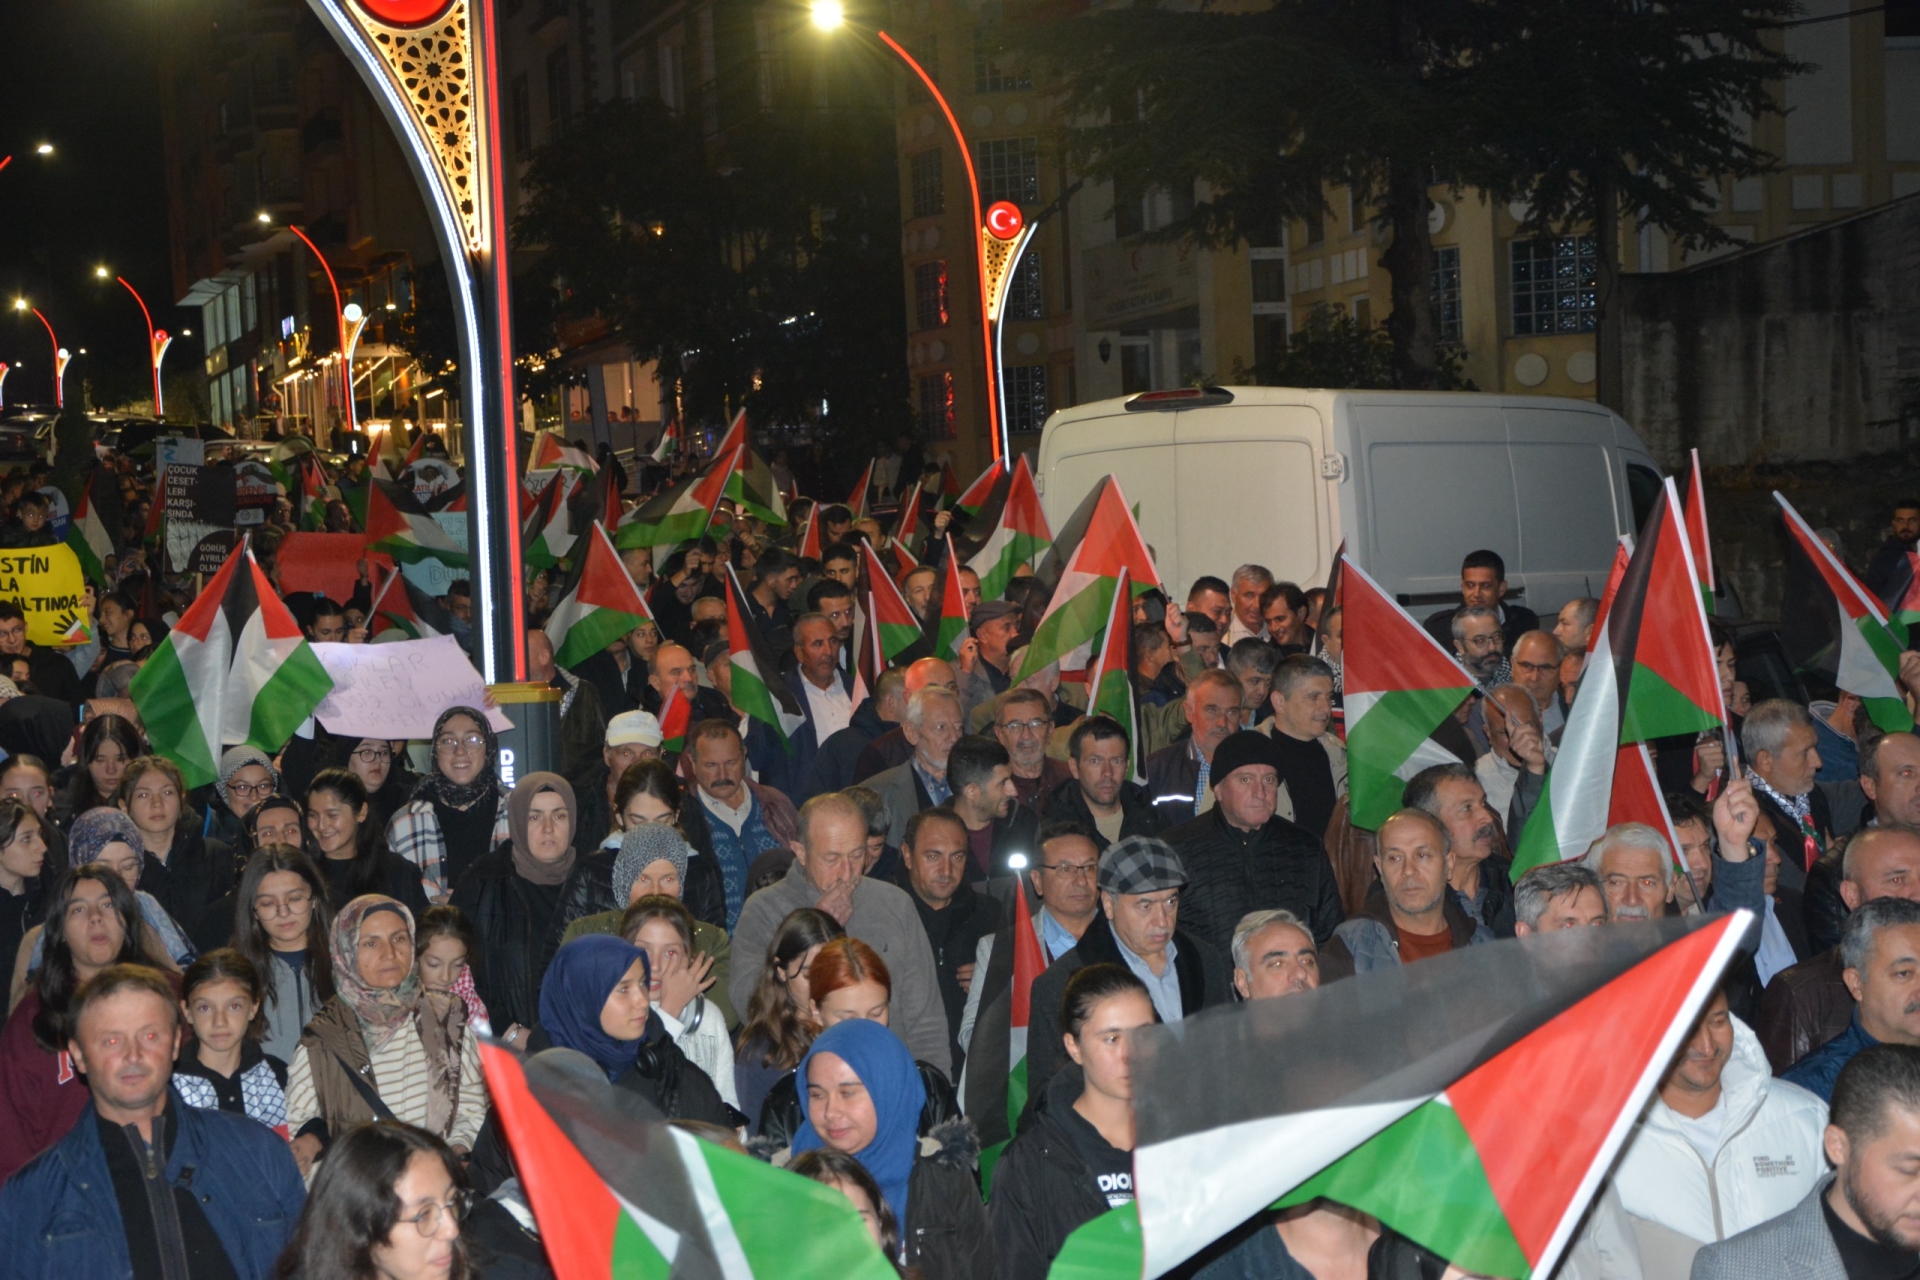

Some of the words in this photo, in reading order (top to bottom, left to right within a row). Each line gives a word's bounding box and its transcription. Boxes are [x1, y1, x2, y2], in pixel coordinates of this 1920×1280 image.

[167, 465, 198, 476] ÇOCUK
[167, 487, 186, 496] LERİ
[166, 509, 194, 519] SINDA
[199, 543, 227, 554] GÖRÜŞ
